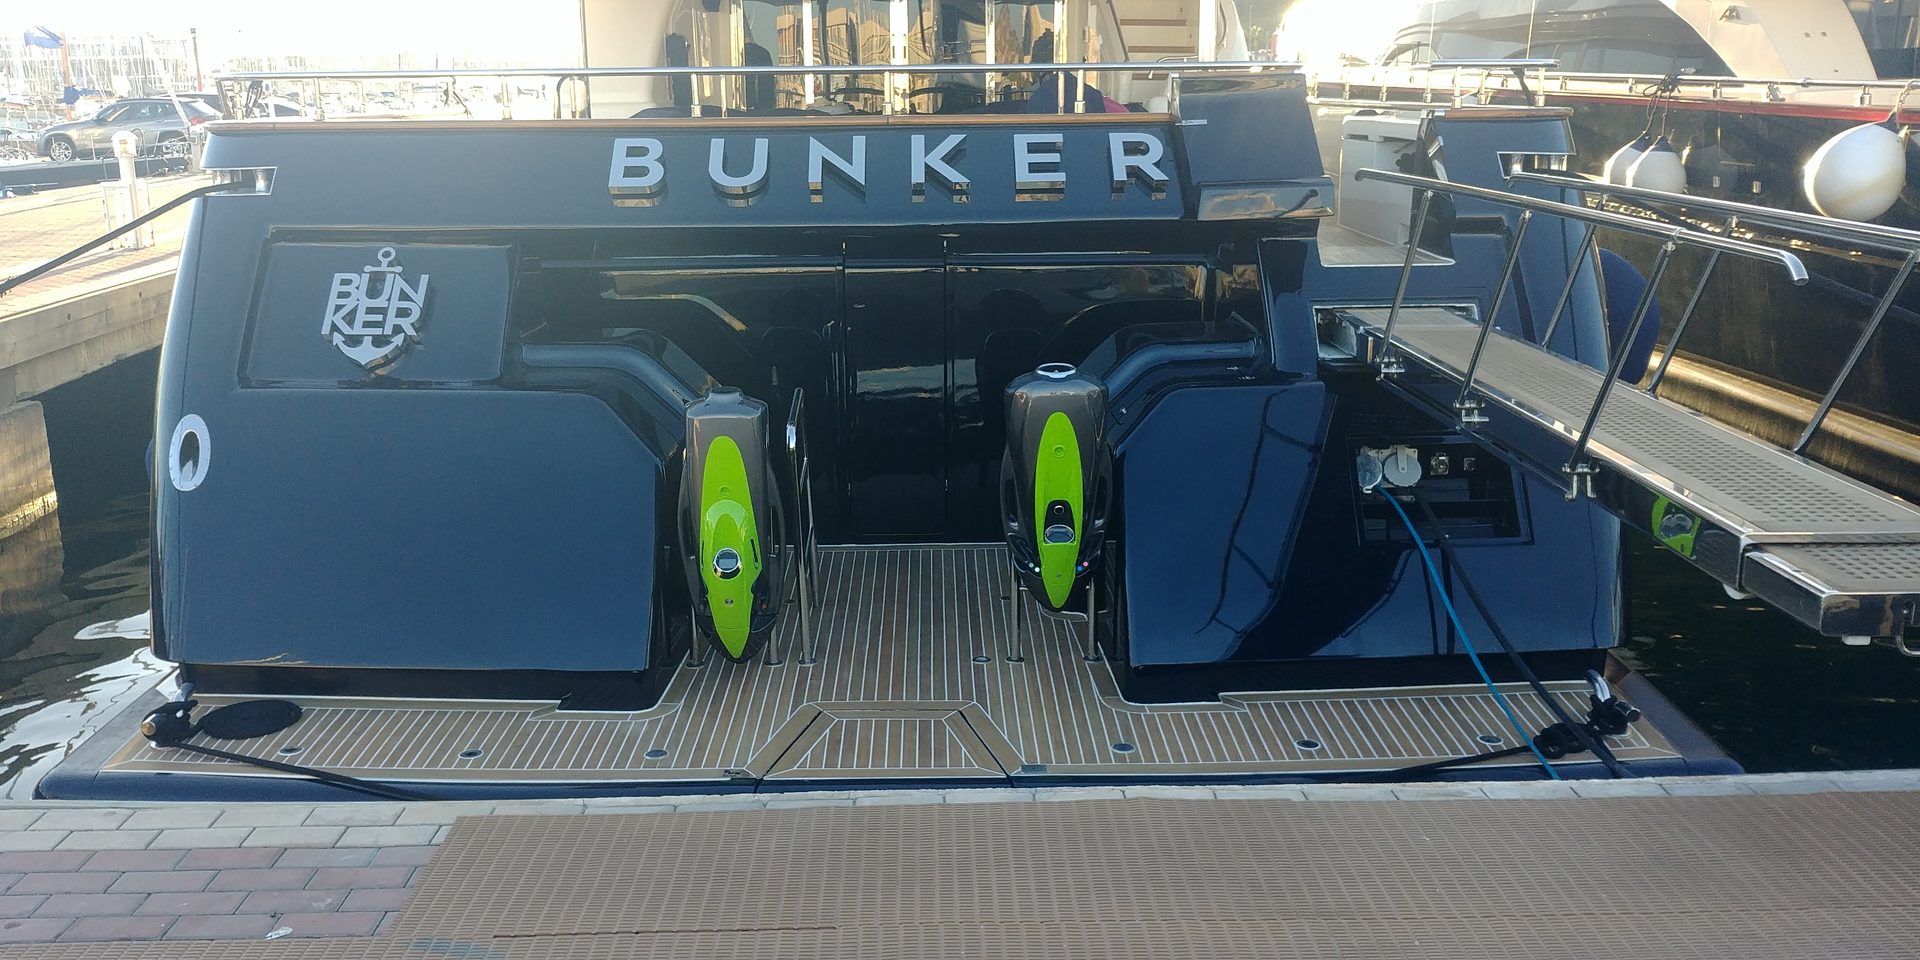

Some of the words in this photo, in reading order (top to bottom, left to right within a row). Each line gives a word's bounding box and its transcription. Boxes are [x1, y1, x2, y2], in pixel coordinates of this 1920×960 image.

[608, 132, 1170, 188] BUNKER
[328, 272, 430, 308] BUN
[320, 300, 421, 335] KER
